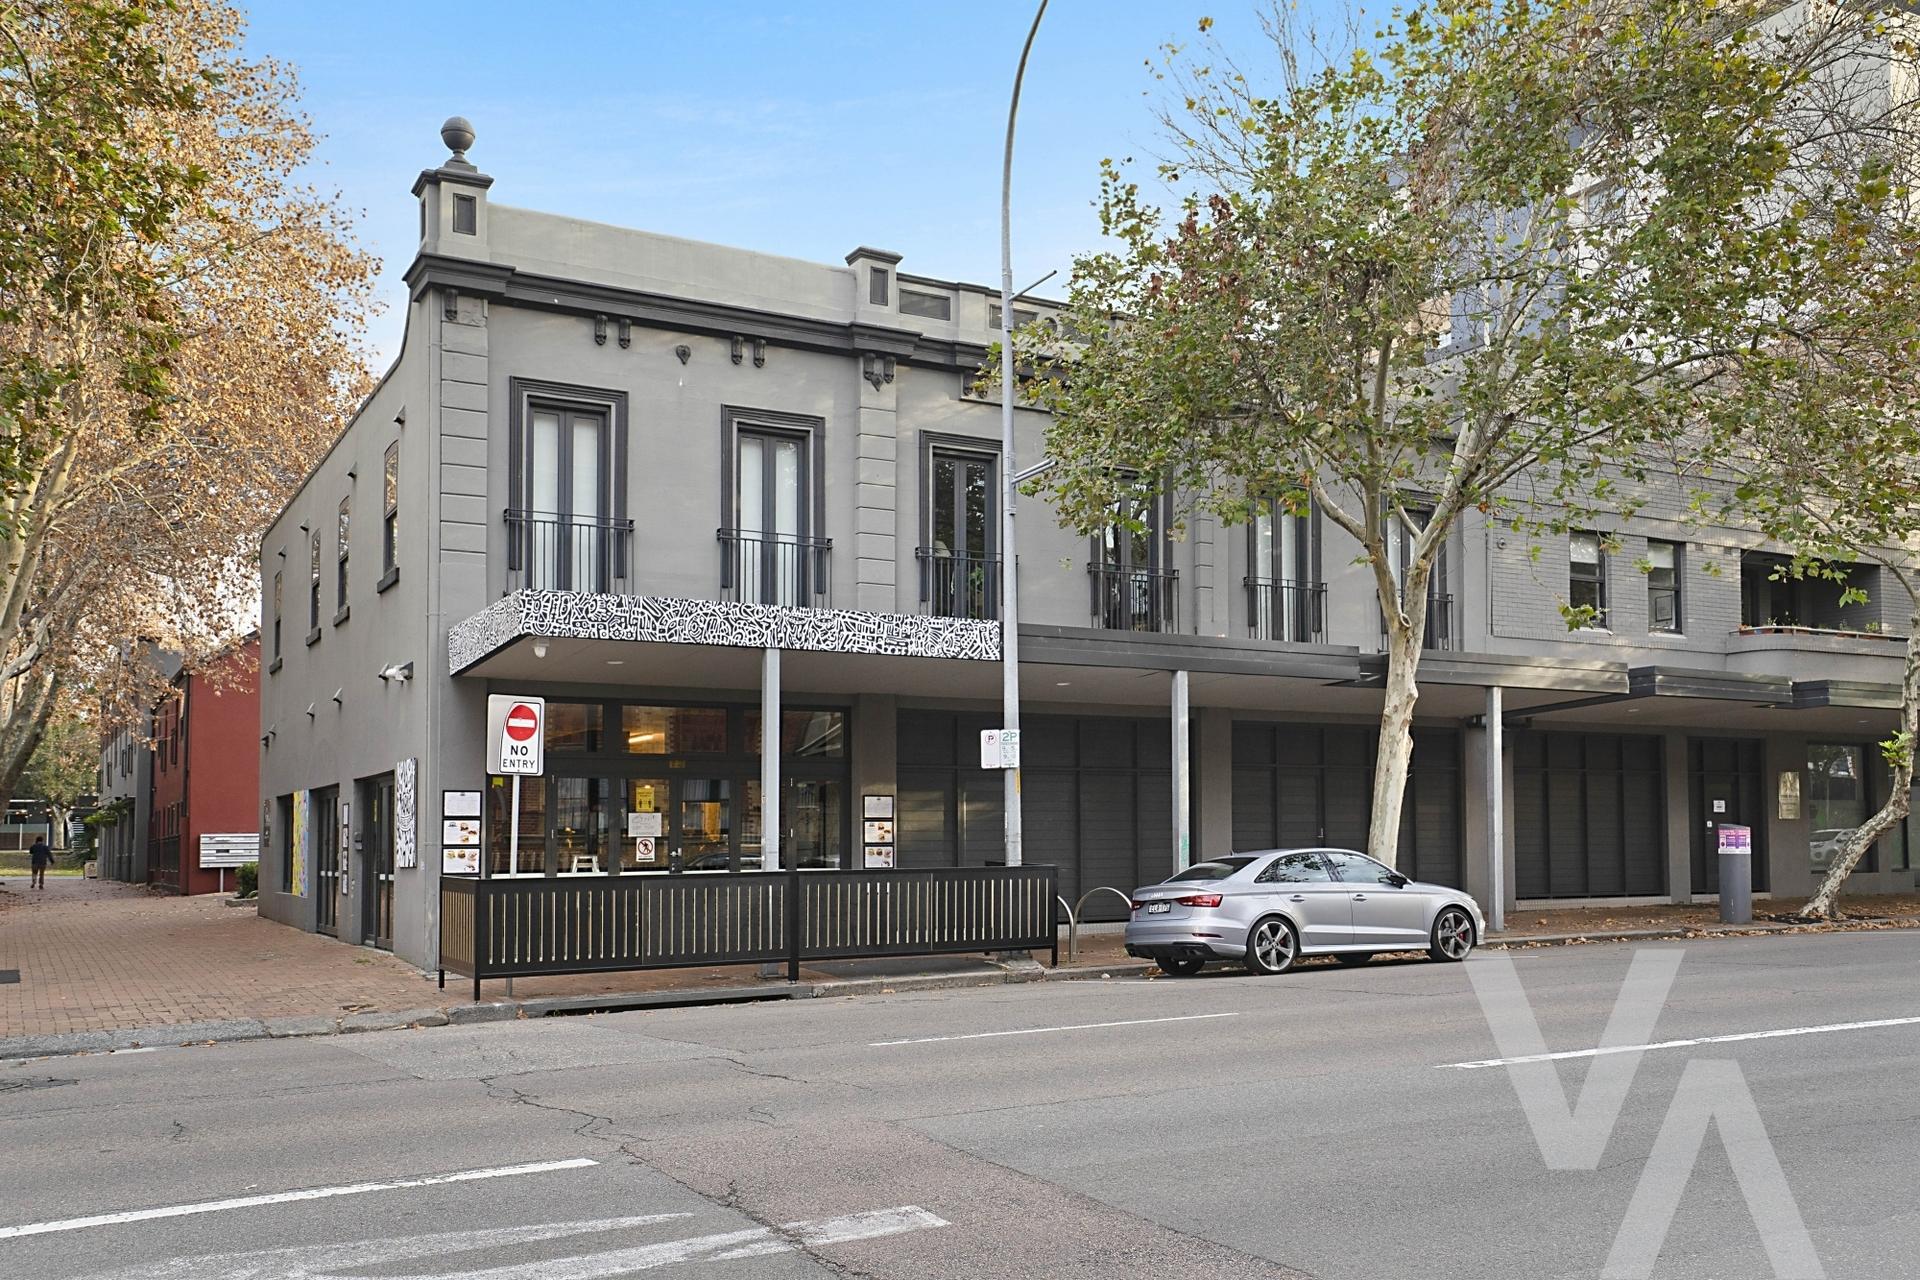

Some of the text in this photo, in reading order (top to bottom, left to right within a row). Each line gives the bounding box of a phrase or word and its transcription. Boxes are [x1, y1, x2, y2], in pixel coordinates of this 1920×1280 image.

[1002, 732, 1017, 741] 2P
[510, 745, 528, 756] NO
[502, 758, 535, 768] ENTRY
